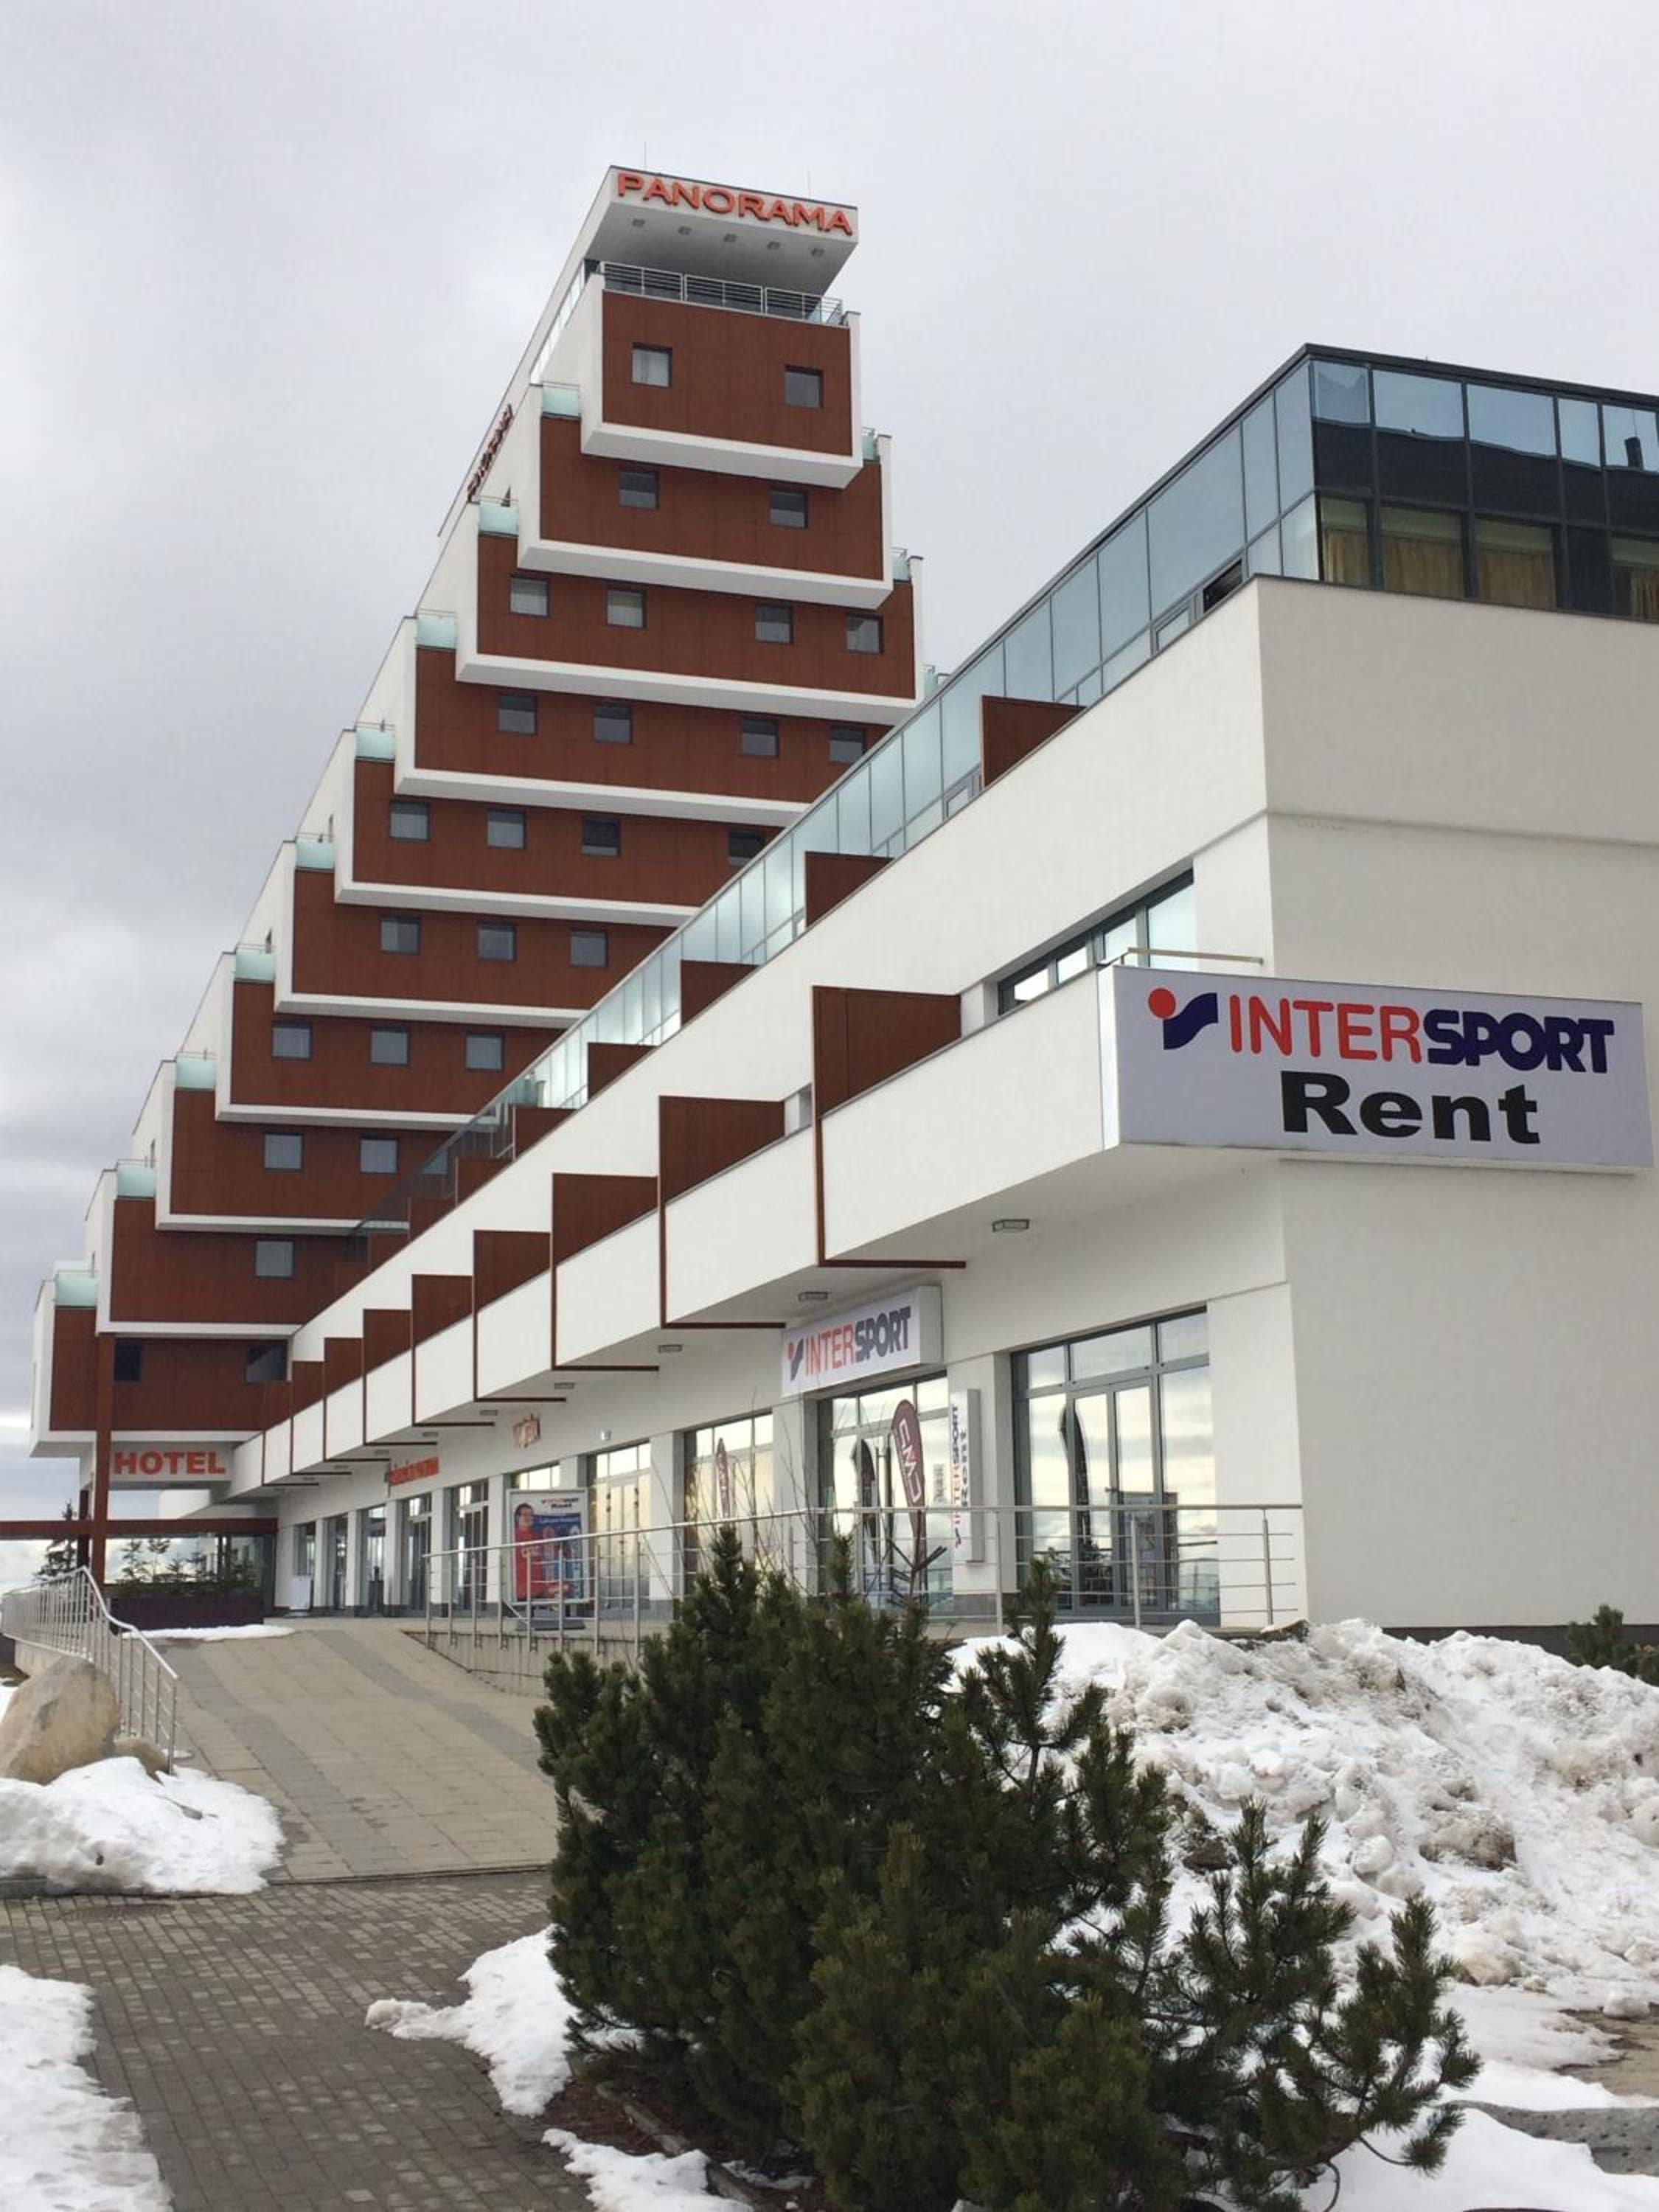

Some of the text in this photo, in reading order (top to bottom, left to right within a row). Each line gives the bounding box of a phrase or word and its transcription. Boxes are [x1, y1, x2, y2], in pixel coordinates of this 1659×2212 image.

[617, 172, 853, 236] PANORAMA
[1229, 994, 1615, 1074] INTERSPORT
[1280, 1070, 1540, 1144] Rent
[805, 1305, 911, 1377] INTERSPORT
[114, 1451, 226, 1475] HOTEL
